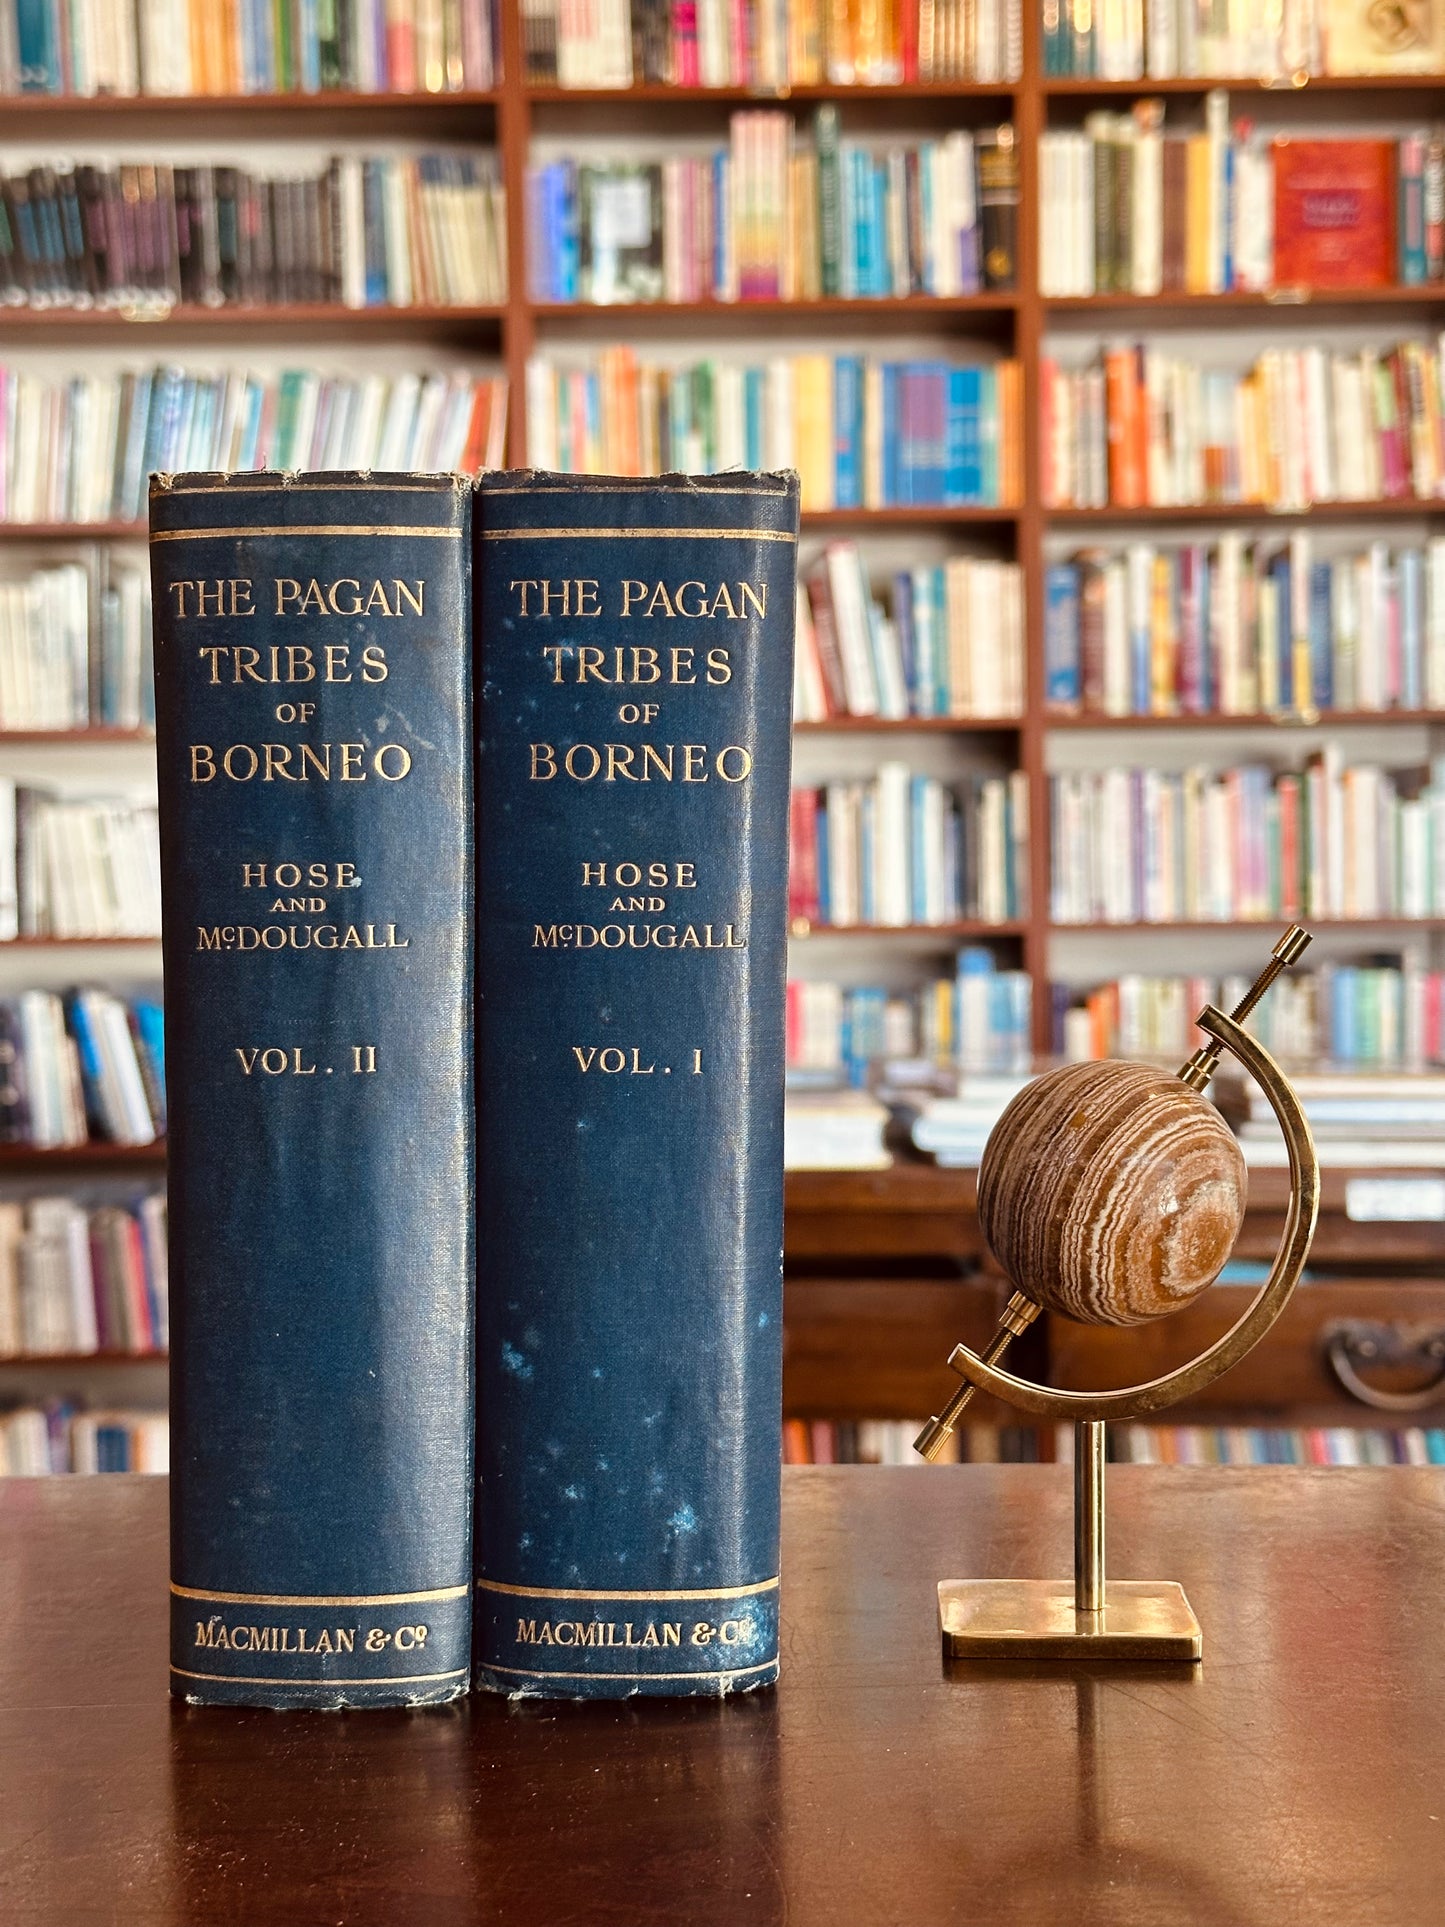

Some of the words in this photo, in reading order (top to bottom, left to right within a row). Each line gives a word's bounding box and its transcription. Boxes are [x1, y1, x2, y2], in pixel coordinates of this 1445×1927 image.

[169, 579, 256, 617] THE
[275, 579, 425, 617] PAGAN
[510, 580, 602, 617] THE
[620, 580, 767, 619] PAGAN
[200, 646, 389, 684] TRIBES
[543, 646, 732, 684] TRIBES
[276, 703, 316, 723] OF
[618, 703, 660, 724] OF
[189, 743, 412, 783] BORNEO
[529, 743, 751, 782] BORNEO
[242, 863, 358, 888] HOSE
[582, 862, 697, 888] HOSE
[269, 897, 327, 912] AND
[609, 896, 666, 912] AND
[236, 1048, 333, 1075] VOL.
[352, 1046, 377, 1073] II
[572, 1047, 671, 1075] VOL.
[693, 1048, 703, 1074] I
[195, 1621, 356, 1652] MACMILLAN
[365, 1628, 392, 1651] &
[515, 1618, 683, 1647] MACMILLAN
[691, 1622, 717, 1646] &
